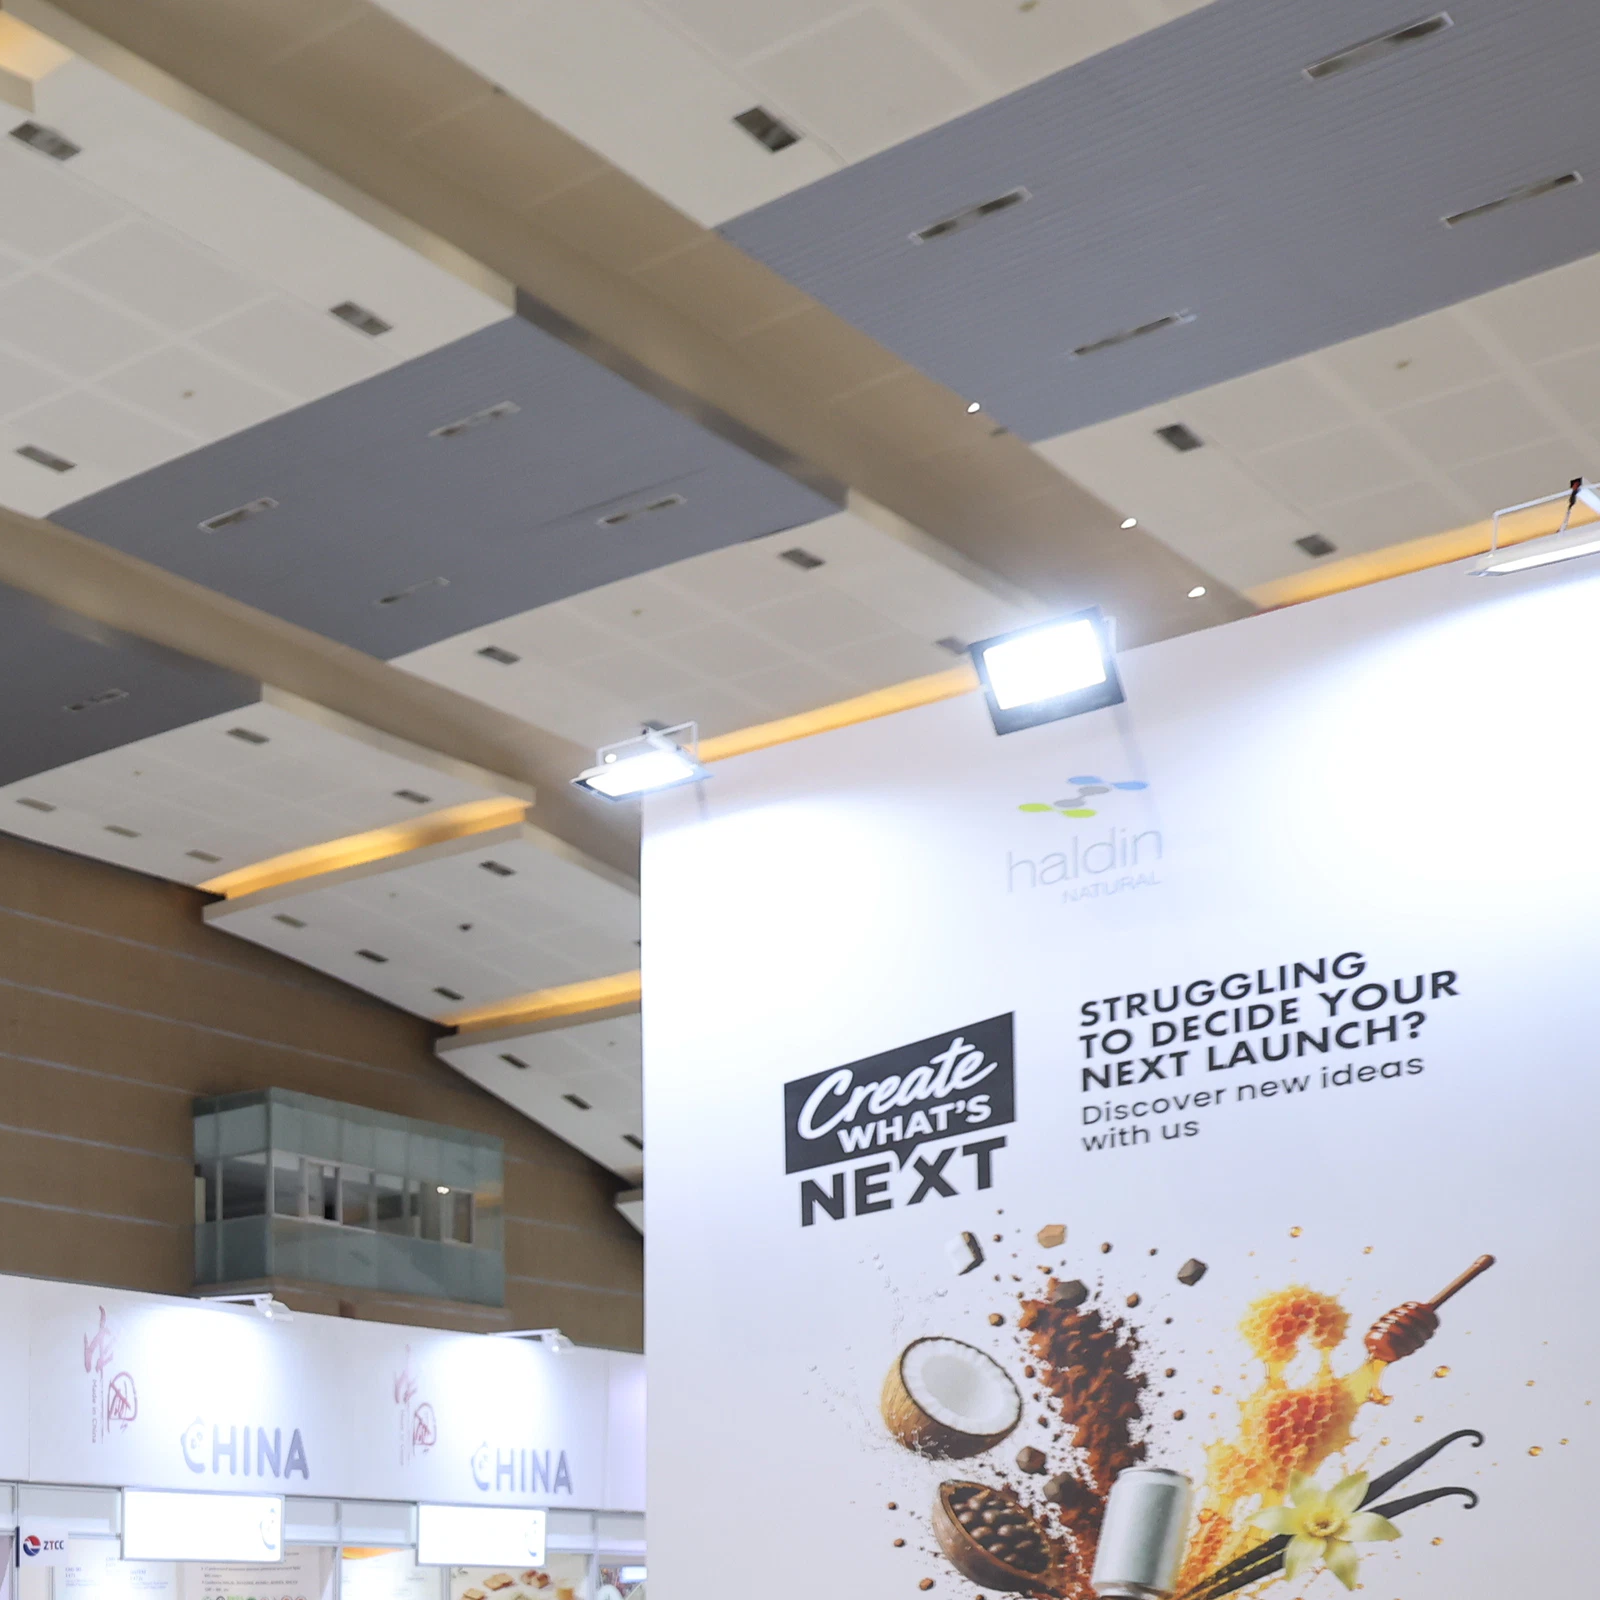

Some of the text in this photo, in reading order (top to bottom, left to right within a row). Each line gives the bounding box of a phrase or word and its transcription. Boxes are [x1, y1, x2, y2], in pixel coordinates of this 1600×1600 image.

[1007, 827, 1162, 892] haldin
[1062, 872, 1161, 903] NATURAL
[1079, 970, 1460, 1058] TO DECIDE YOUR
[1080, 952, 1366, 1027] STRUGGLING
[1082, 1011, 1426, 1092] NEXT LAUNCH?
[797, 1037, 998, 1140] Create
[1082, 1057, 1425, 1125] Discover new ideas
[837, 1094, 992, 1154] WHAT'S
[1081, 1120, 1200, 1152] with us
[801, 1135, 1008, 1228] NEXT
[180, 1416, 310, 1480] CHINA
[471, 1441, 574, 1496] CHINA
[43, 1540, 64, 1550] ZTCC
